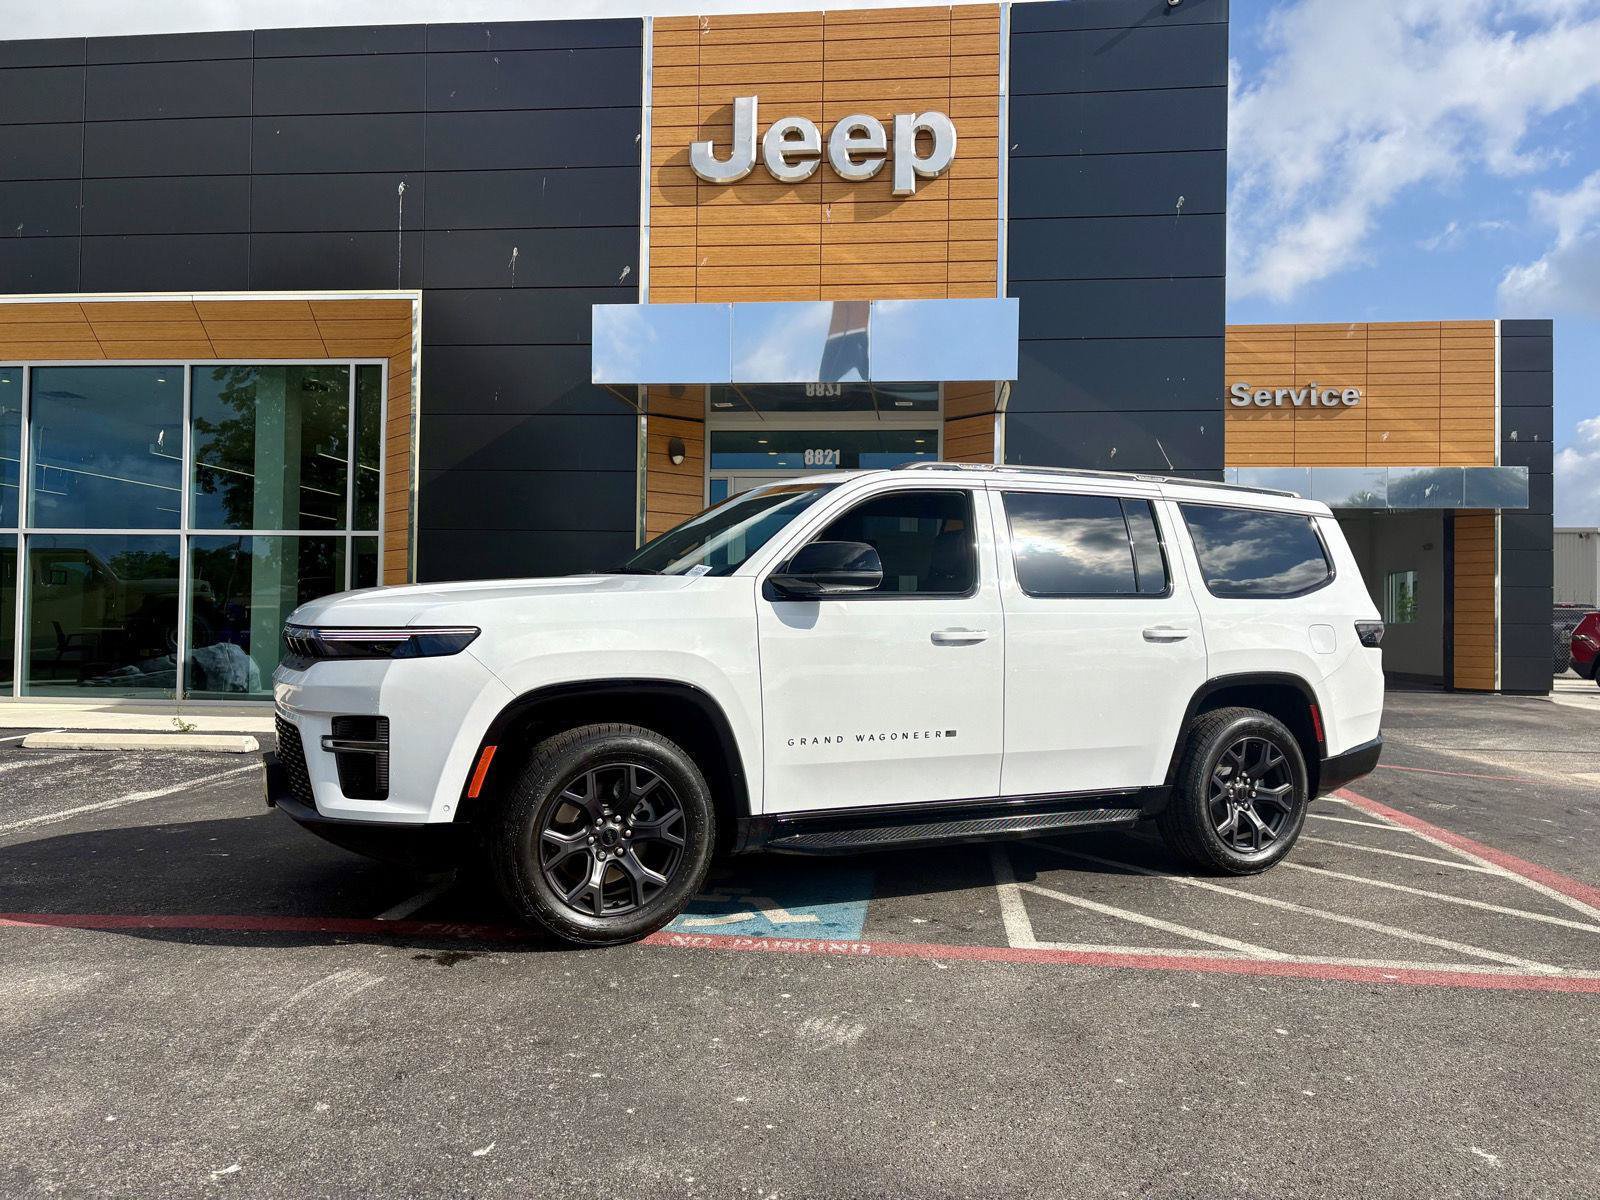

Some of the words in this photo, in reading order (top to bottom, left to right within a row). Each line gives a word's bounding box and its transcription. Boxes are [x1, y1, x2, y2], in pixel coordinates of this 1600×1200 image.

[689, 95, 957, 196] Jeep
[1230, 382, 1360, 407] Service
[804, 448, 841, 465] 8821
[787, 735, 844, 747] GRAND
[855, 730, 942, 742] WAGONEER
